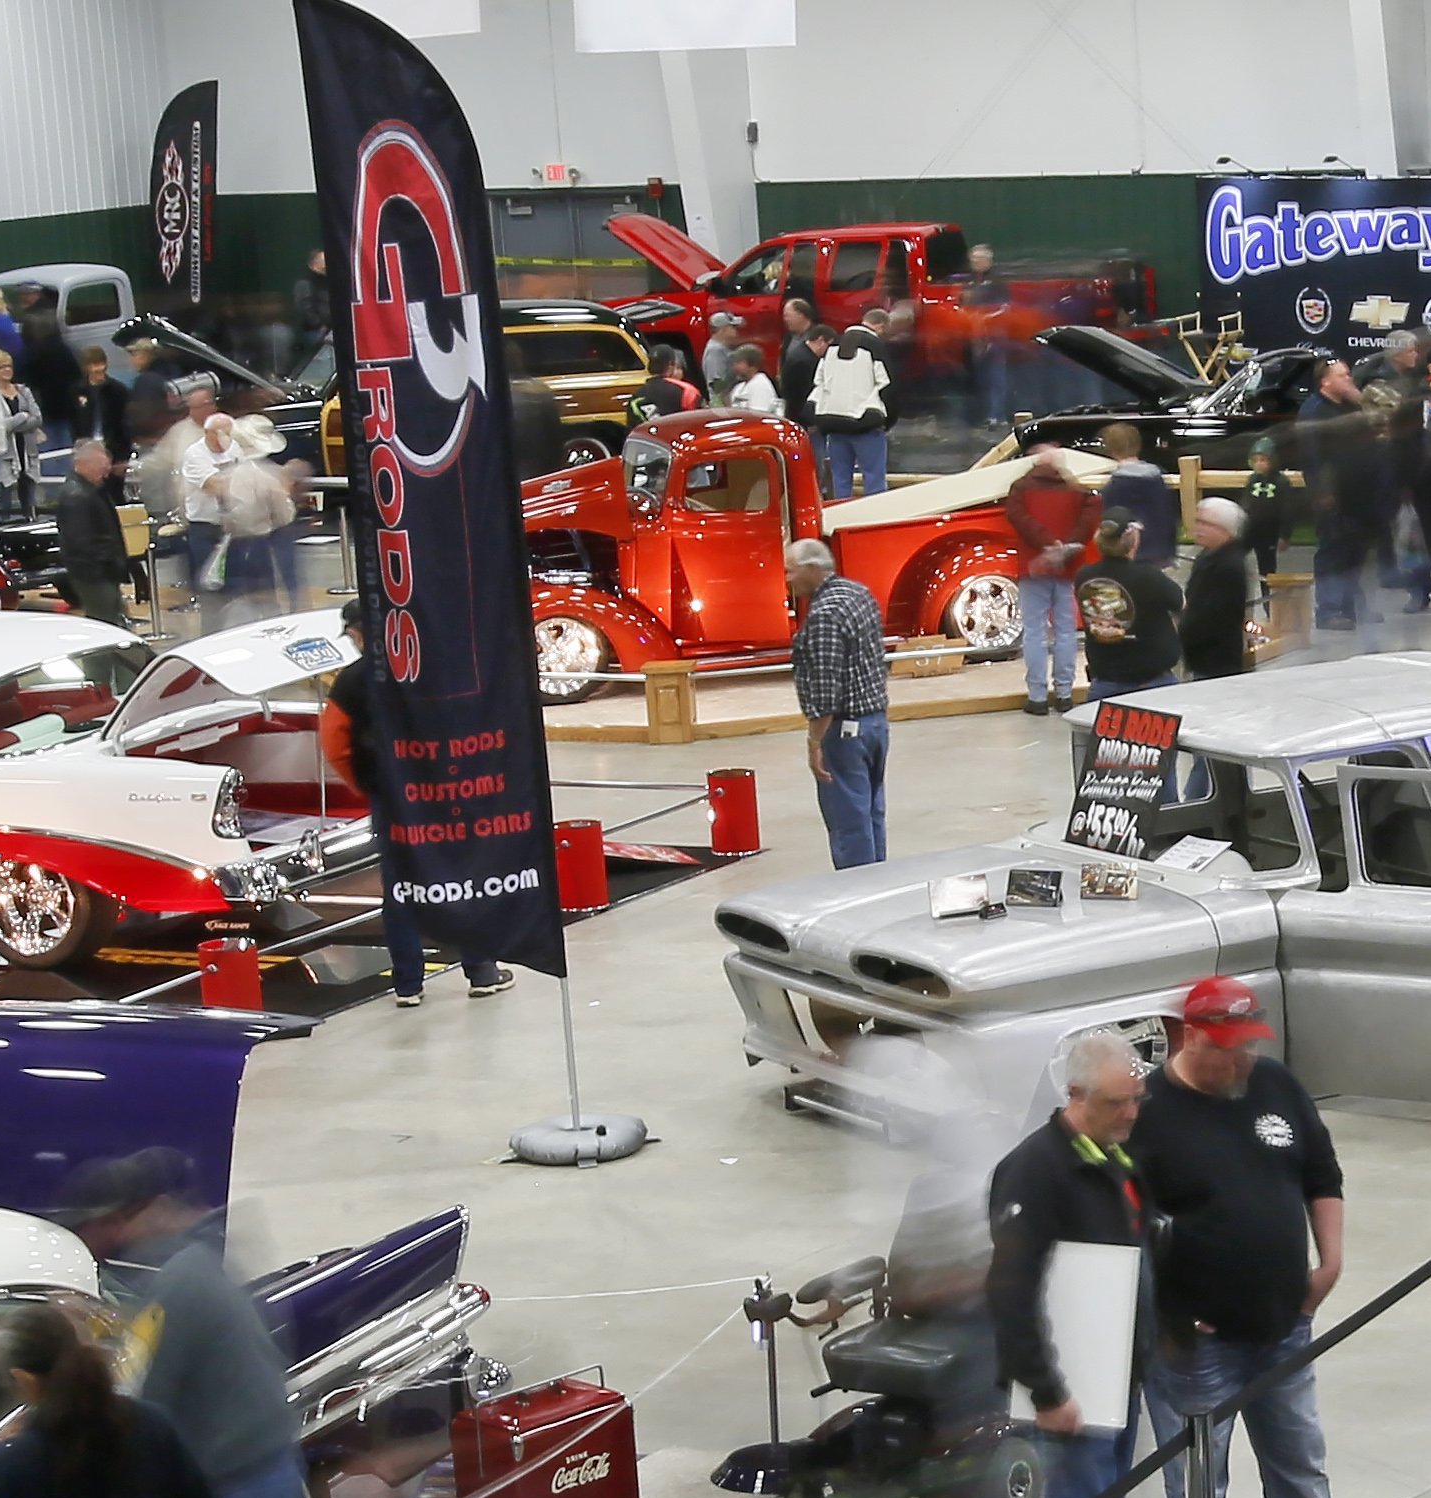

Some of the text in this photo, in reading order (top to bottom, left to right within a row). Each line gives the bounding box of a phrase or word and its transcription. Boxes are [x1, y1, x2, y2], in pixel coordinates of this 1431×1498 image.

[163, 188, 182, 233] MRC
[355, 366, 421, 684] RODS
[394, 728, 505, 759] HOT RODS
[1095, 704, 1177, 750] G3 RODS
[1095, 737, 1162, 767] SHOP RATE
[404, 773, 506, 803] CUSTOMS
[389, 810, 533, 847] MUSCLE CARS
[550, 1452, 611, 1494] Coca-Cola
